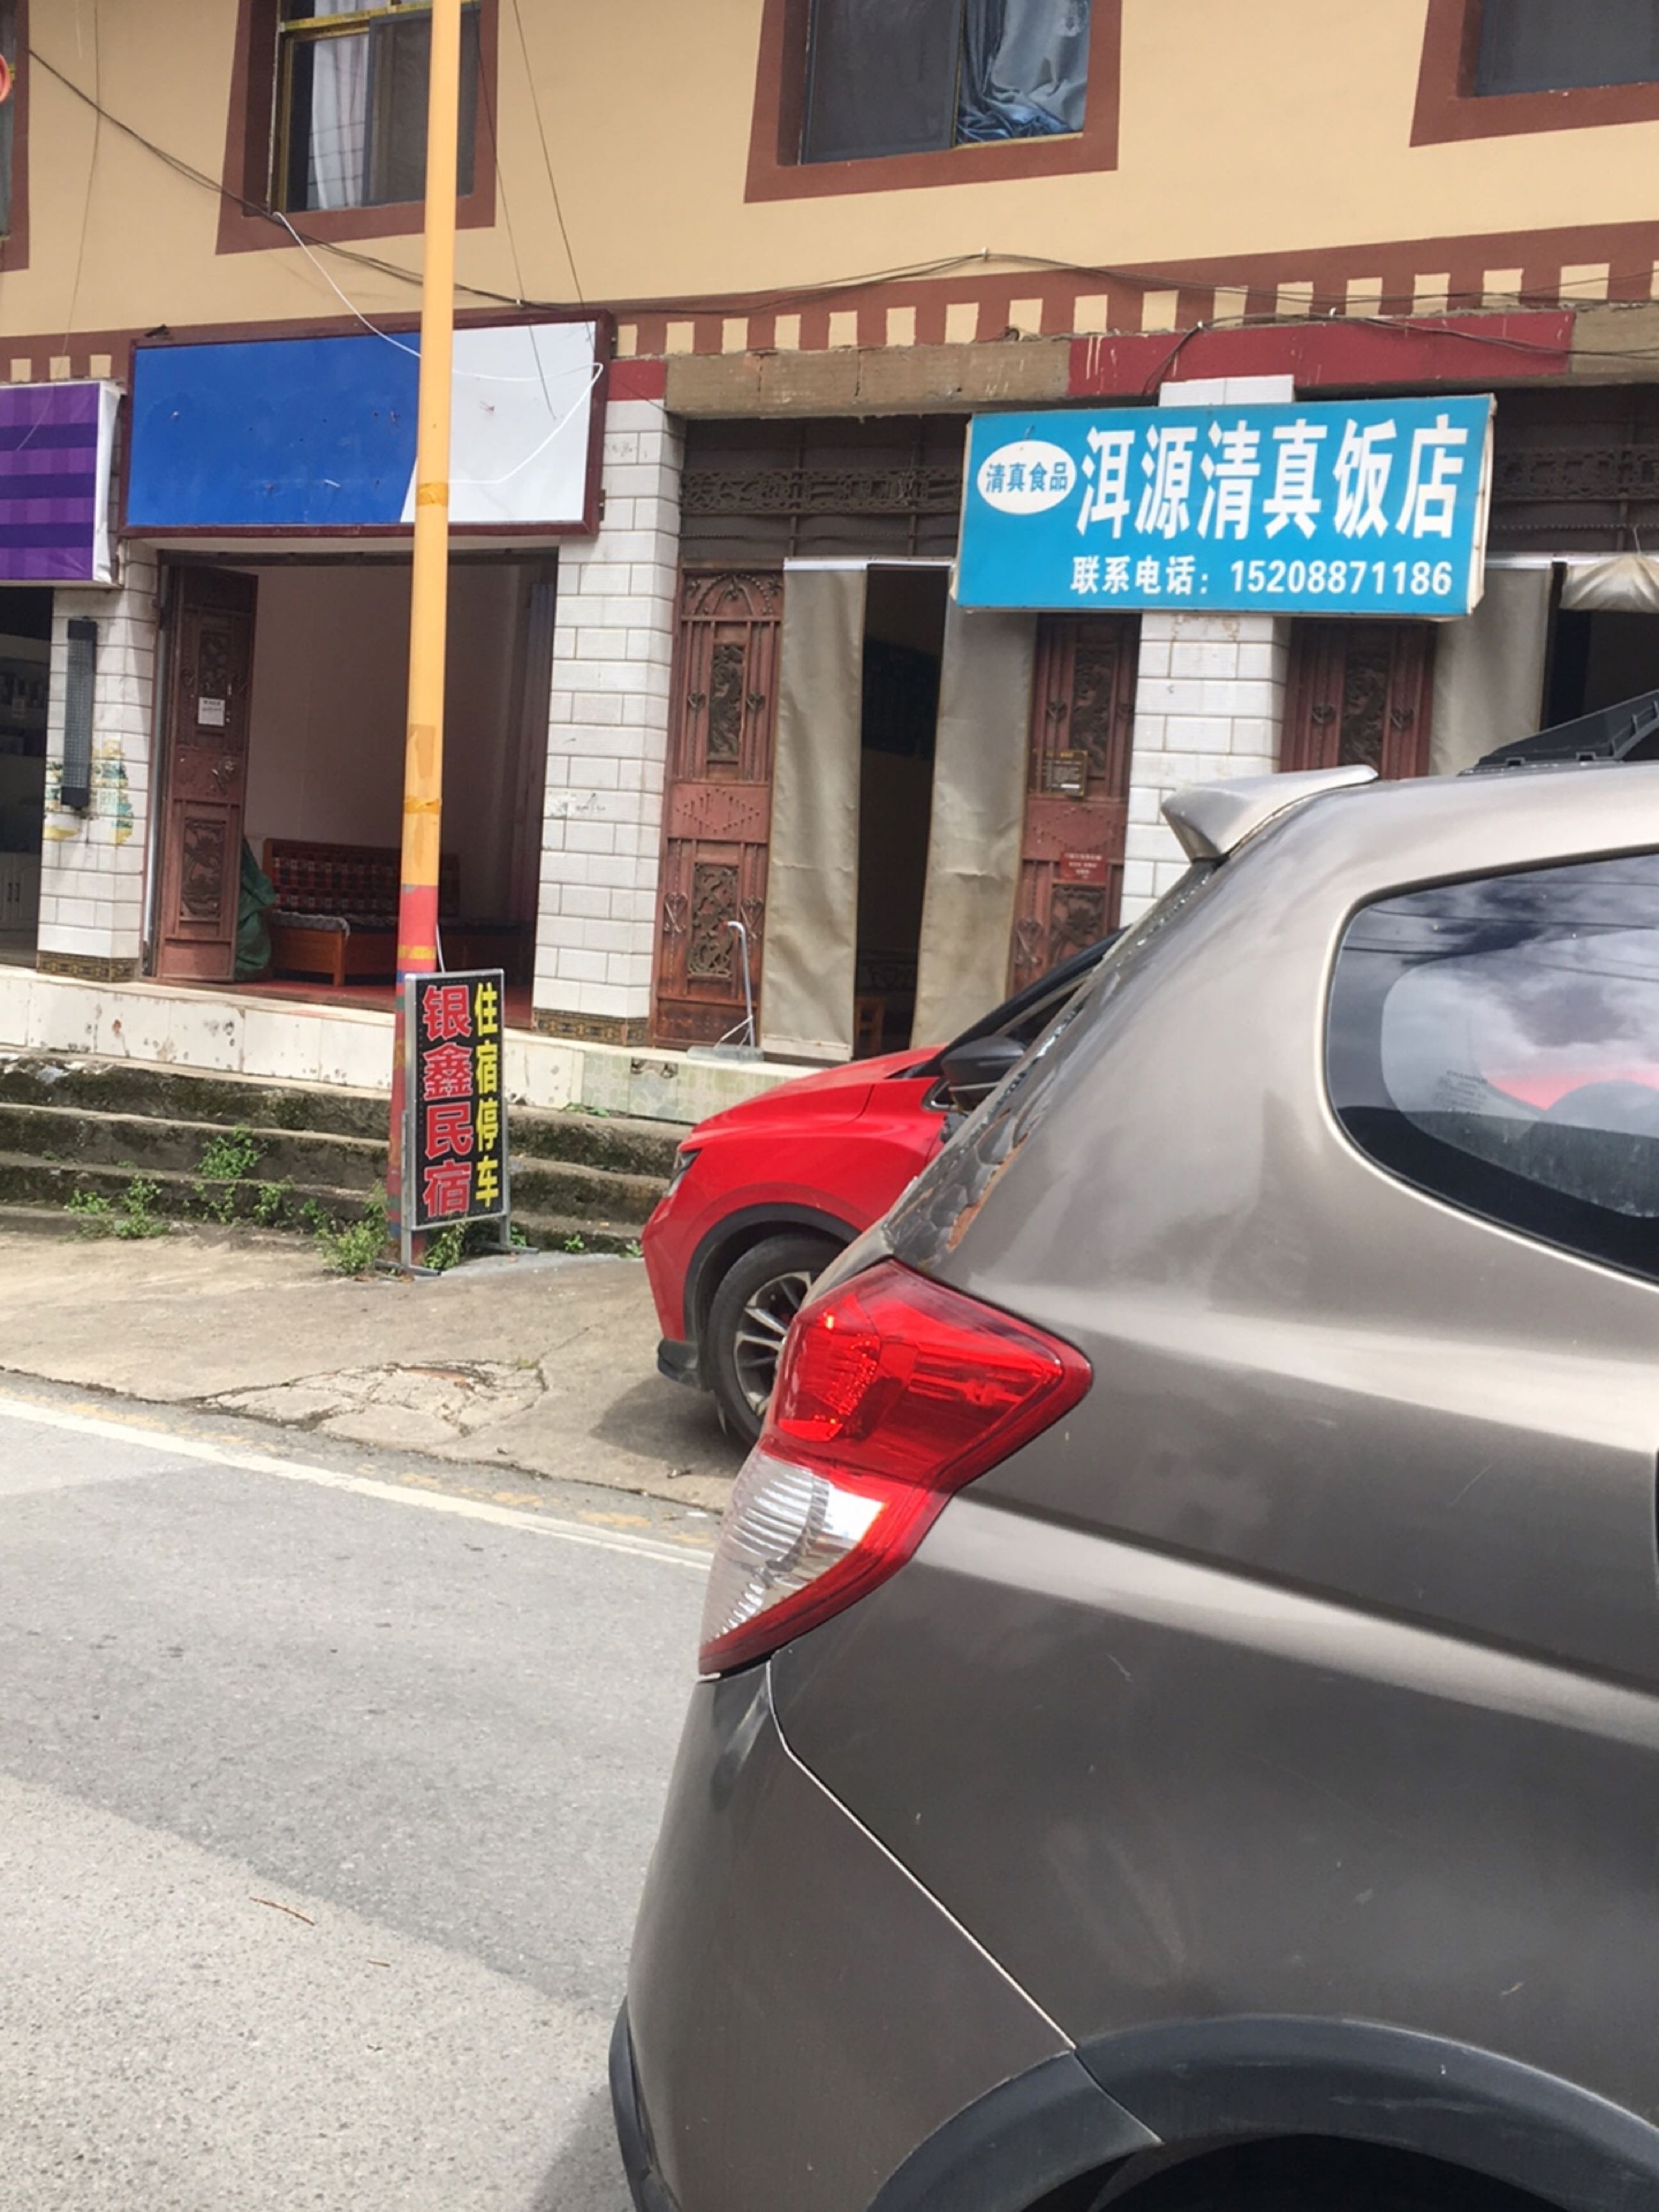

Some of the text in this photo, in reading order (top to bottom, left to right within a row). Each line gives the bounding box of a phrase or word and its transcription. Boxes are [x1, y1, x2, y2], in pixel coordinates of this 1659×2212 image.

[985, 461, 1069, 494] 清真食品
[1077, 414, 1468, 540] 洱源清真饭店
[422, 984, 472, 1217] 银鑫民宿
[474, 982, 499, 1208] 住宿停车
